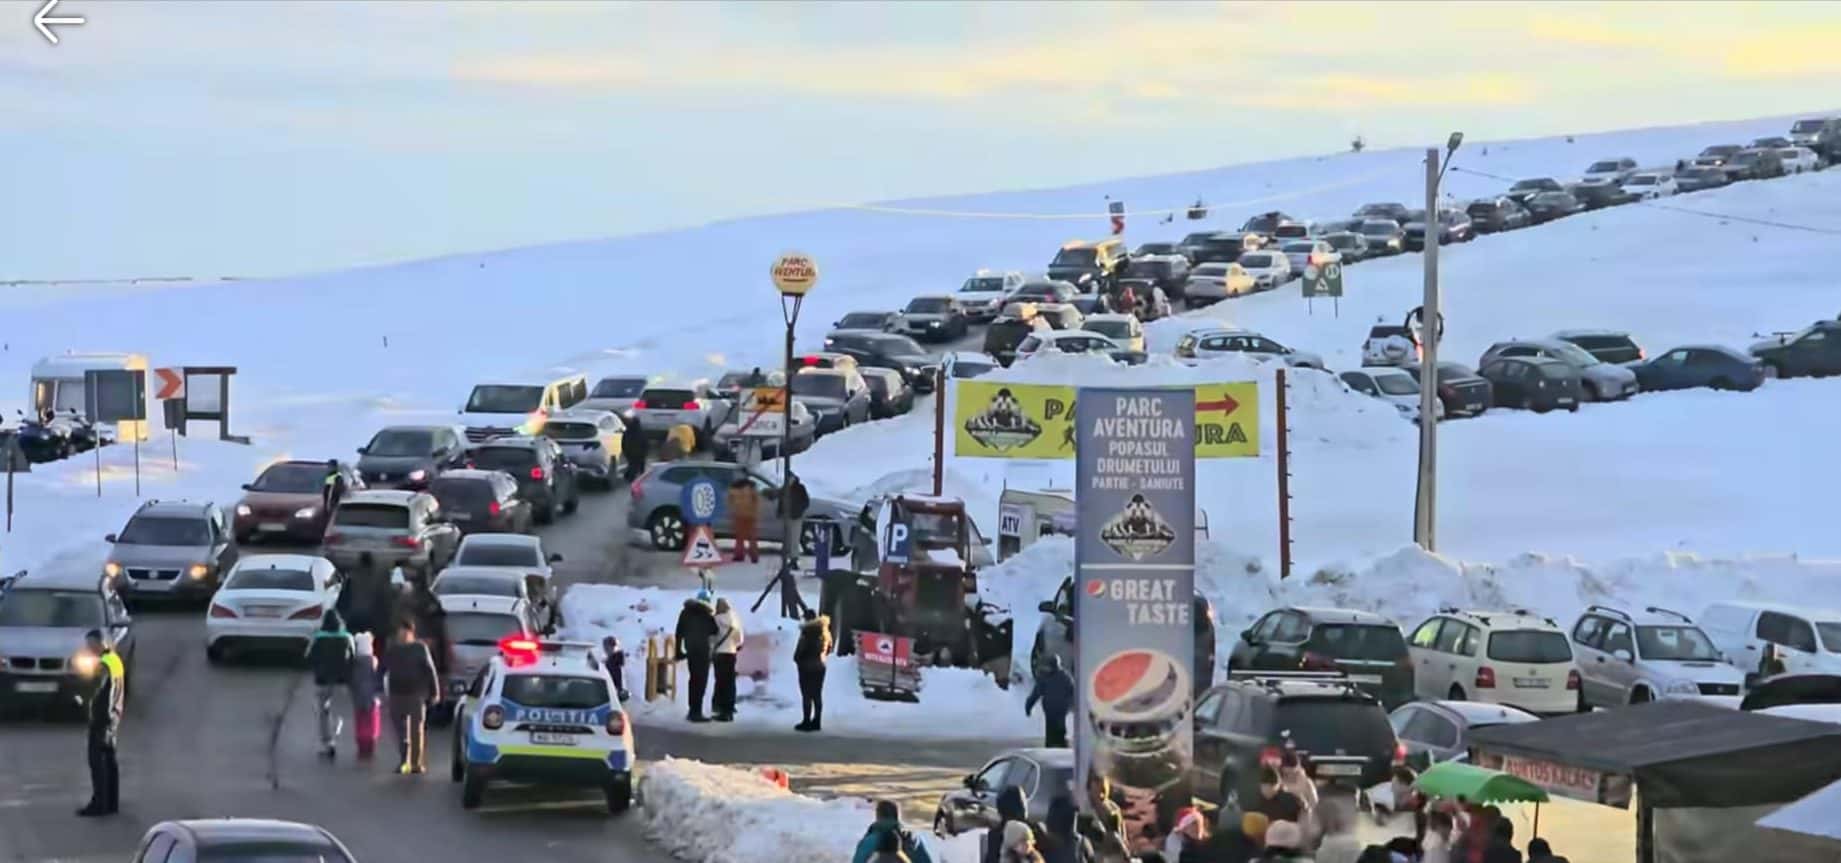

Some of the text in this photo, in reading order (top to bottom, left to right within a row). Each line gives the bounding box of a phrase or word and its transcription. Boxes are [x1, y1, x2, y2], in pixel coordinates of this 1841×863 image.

[1116, 398, 1162, 416] PARC
[1093, 418, 1185, 438] AVENTURA
[1195, 422, 1248, 444] RA
[1109, 440, 1168, 456] POPASUL
[1097, 458, 1181, 474] DRUMETULUI
[1092, 476, 1129, 489] PARTIE
[1002, 516, 1020, 534] ATV
[891, 523, 908, 552] P
[1110, 579, 1176, 601] GREAT
[1126, 603, 1190, 625] TASTE
